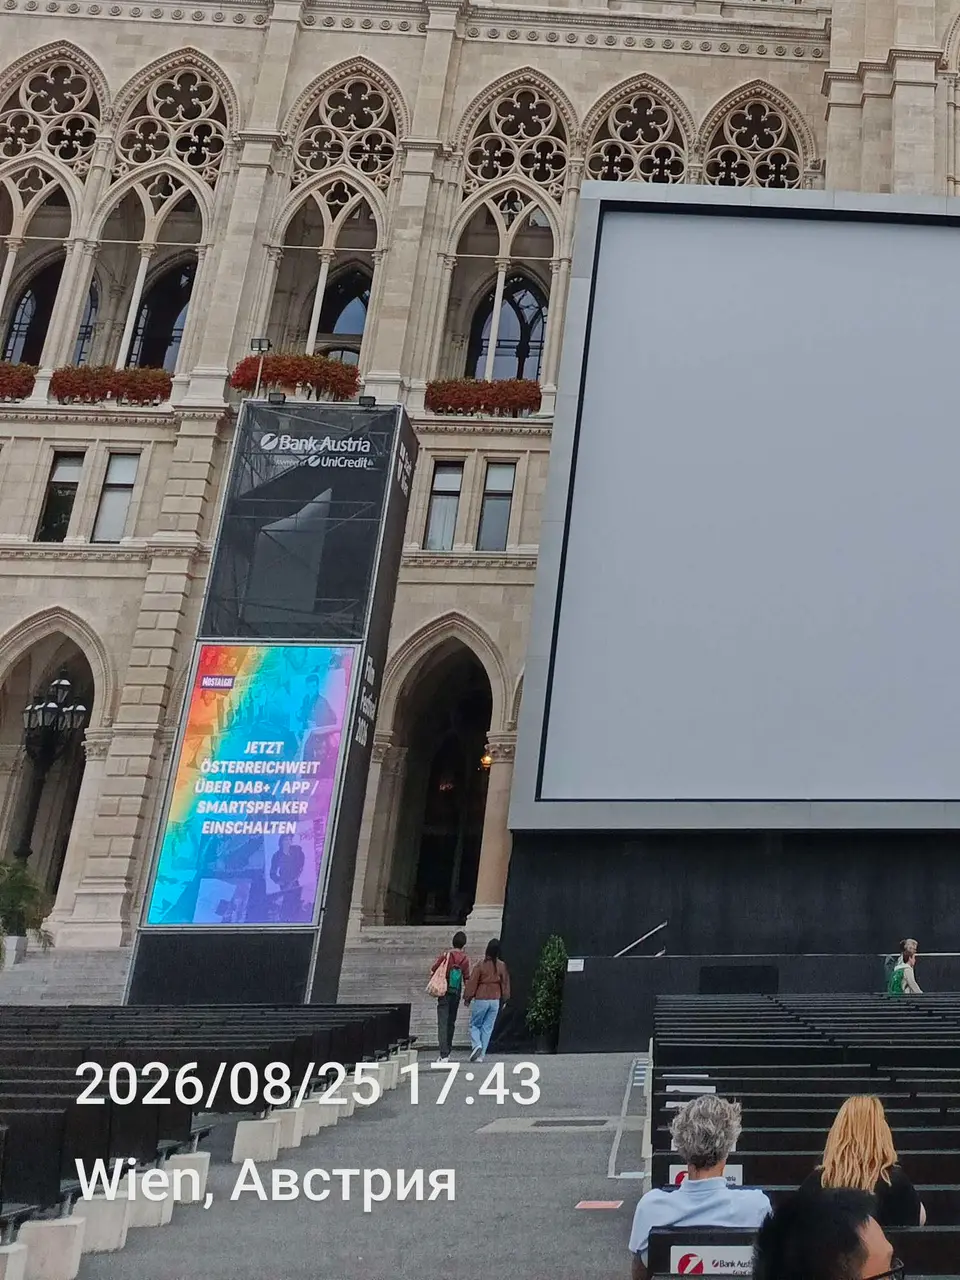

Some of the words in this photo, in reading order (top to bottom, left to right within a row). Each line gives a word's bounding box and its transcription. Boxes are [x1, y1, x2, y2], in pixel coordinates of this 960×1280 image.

[278, 434, 318, 452] Bank
[320, 436, 371, 453] Austria
[321, 456, 368, 468] UniCredit
[244, 741, 284, 754] JETZT
[201, 758, 320, 774] ÖSTERREICHWEIT
[195, 777, 231, 794] ÜBER
[234, 781, 270, 794] DAB+
[281, 781, 310, 794] APP
[196, 800, 309, 814] SMARTSPEAKER
[201, 821, 297, 834] EINSCHALTEN
[719, 1259, 735, 1268] Bank
[737, 1259, 752, 1268] Aust
